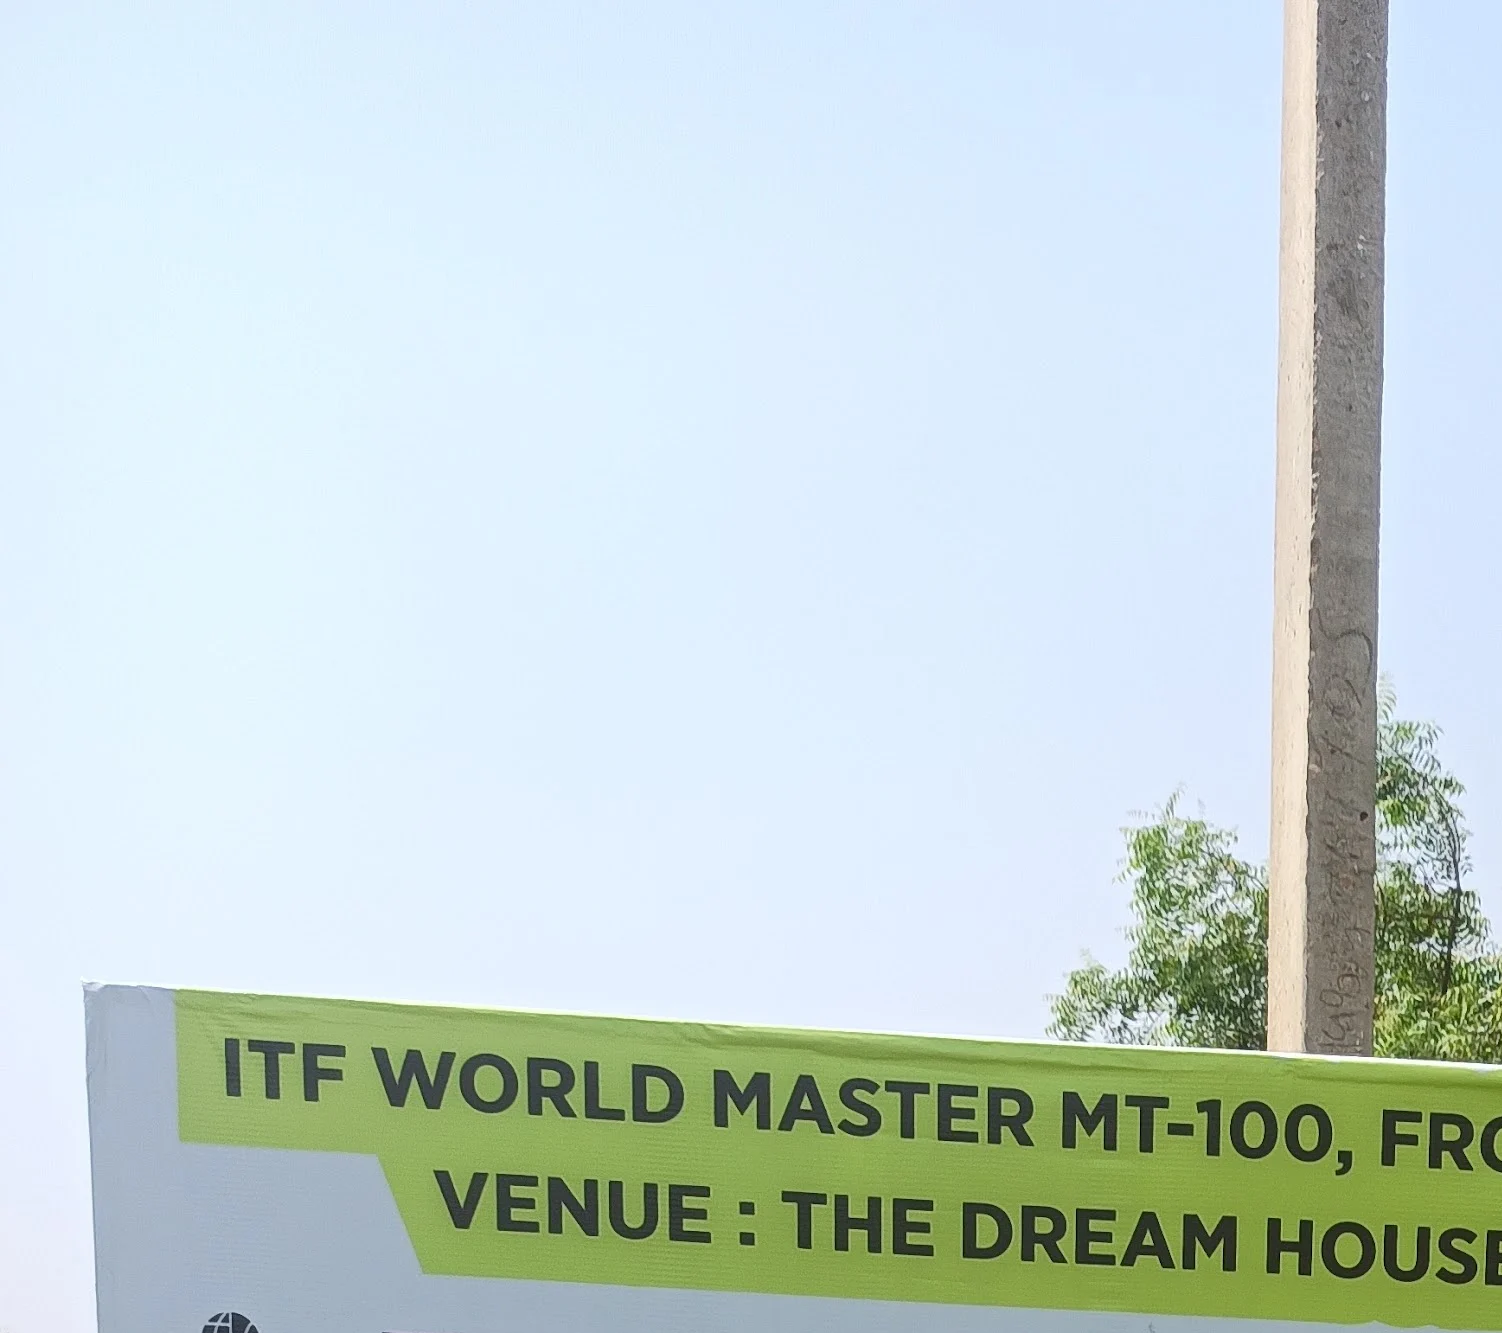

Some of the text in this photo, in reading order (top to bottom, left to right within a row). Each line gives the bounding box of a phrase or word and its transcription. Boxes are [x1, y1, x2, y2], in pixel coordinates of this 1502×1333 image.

[225, 1038, 346, 1102] ITF
[371, 1047, 684, 1123] WORLD
[714, 1069, 1034, 1146] MASTER
[1062, 1091, 1352, 1176] MT-100,
[433, 1170, 711, 1243] VENUE
[782, 1191, 934, 1256] THE
[963, 1202, 1237, 1272] DREAM
